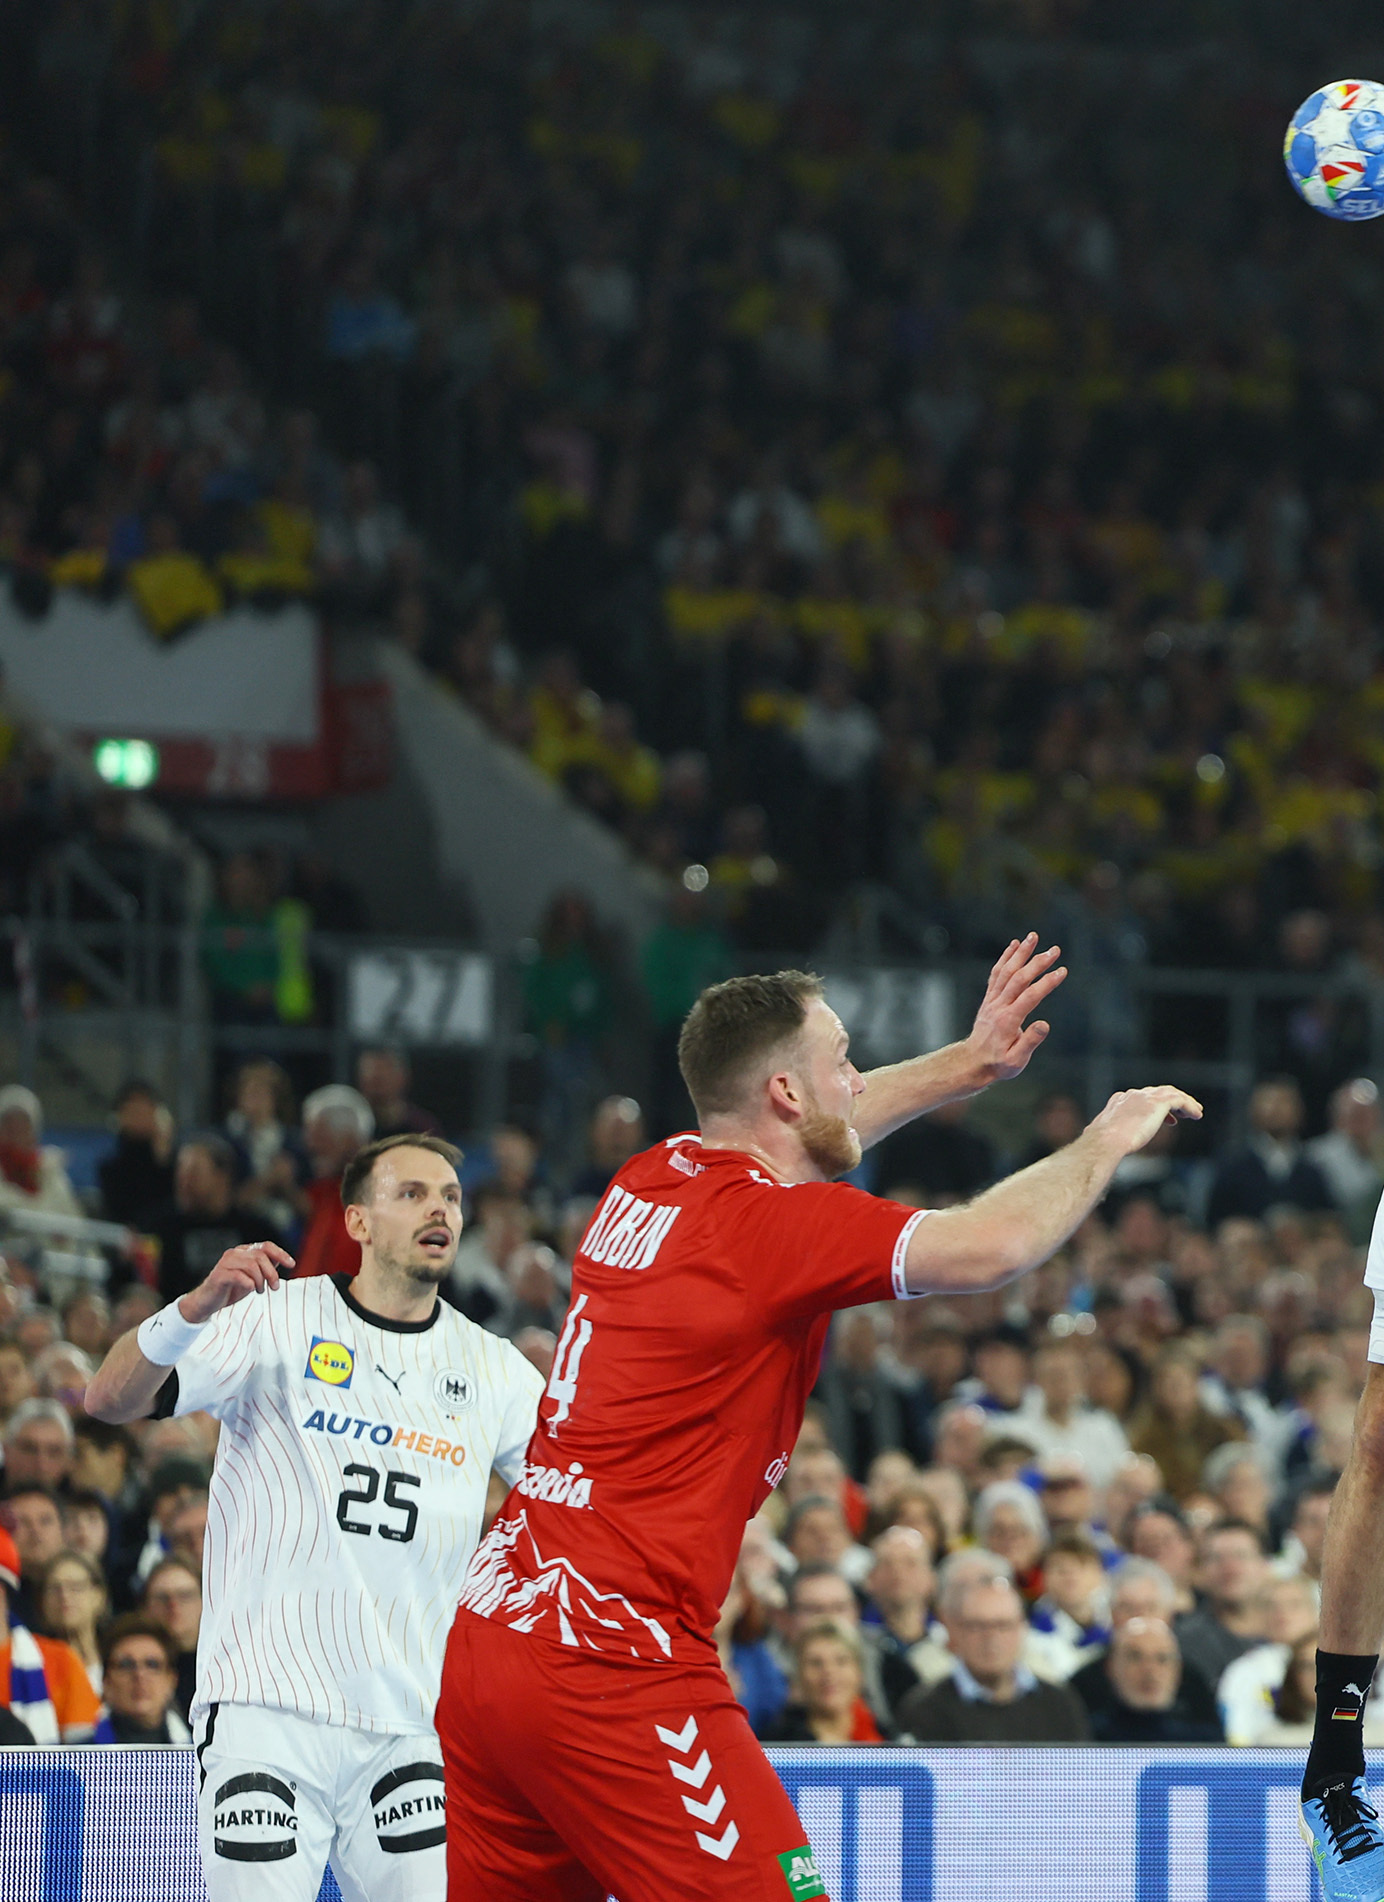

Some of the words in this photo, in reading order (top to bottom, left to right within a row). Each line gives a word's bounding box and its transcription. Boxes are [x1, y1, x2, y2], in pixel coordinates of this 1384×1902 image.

[580, 1184, 682, 1271] RUBIN
[546, 1293, 593, 1438] 4
[302, 1409, 467, 1467] AUTOHERO
[336, 1462, 421, 1543] 25
[214, 1809, 298, 1831] HARTING
[374, 1795, 447, 1829] HARTIN
